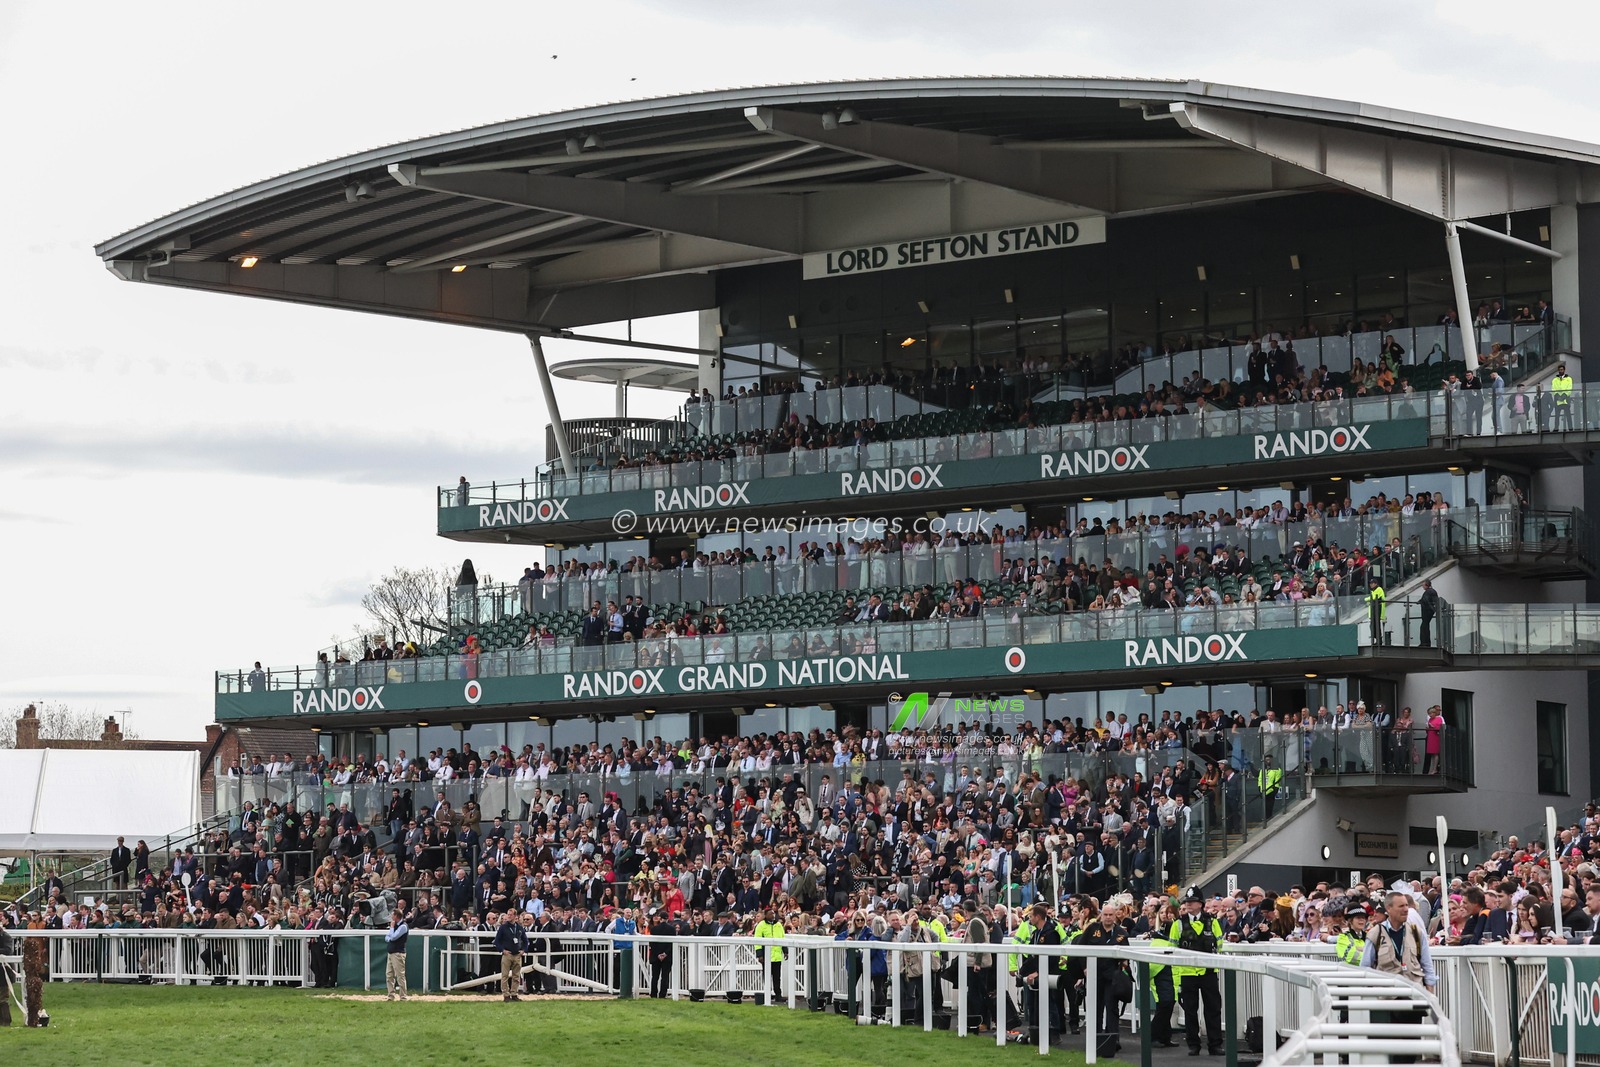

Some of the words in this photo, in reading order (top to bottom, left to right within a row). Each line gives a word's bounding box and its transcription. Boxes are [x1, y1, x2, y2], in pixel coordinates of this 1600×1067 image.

[826, 246, 888, 275] LORD
[897, 233, 988, 265] SEFTON
[997, 221, 1079, 252] STAND
[1254, 424, 1371, 460] RANDOX
[1041, 444, 1150, 478] RANDOX
[654, 482, 750, 512] RANDOX
[840, 464, 943, 496] RANDOX
[479, 498, 569, 527] RANDOX
[1125, 632, 1248, 667] RANDOX
[563, 668, 664, 698] RANDOX
[677, 662, 767, 692] GRAND
[778, 654, 909, 686] NATIONAL
[292, 685, 385, 714] RANDOX
